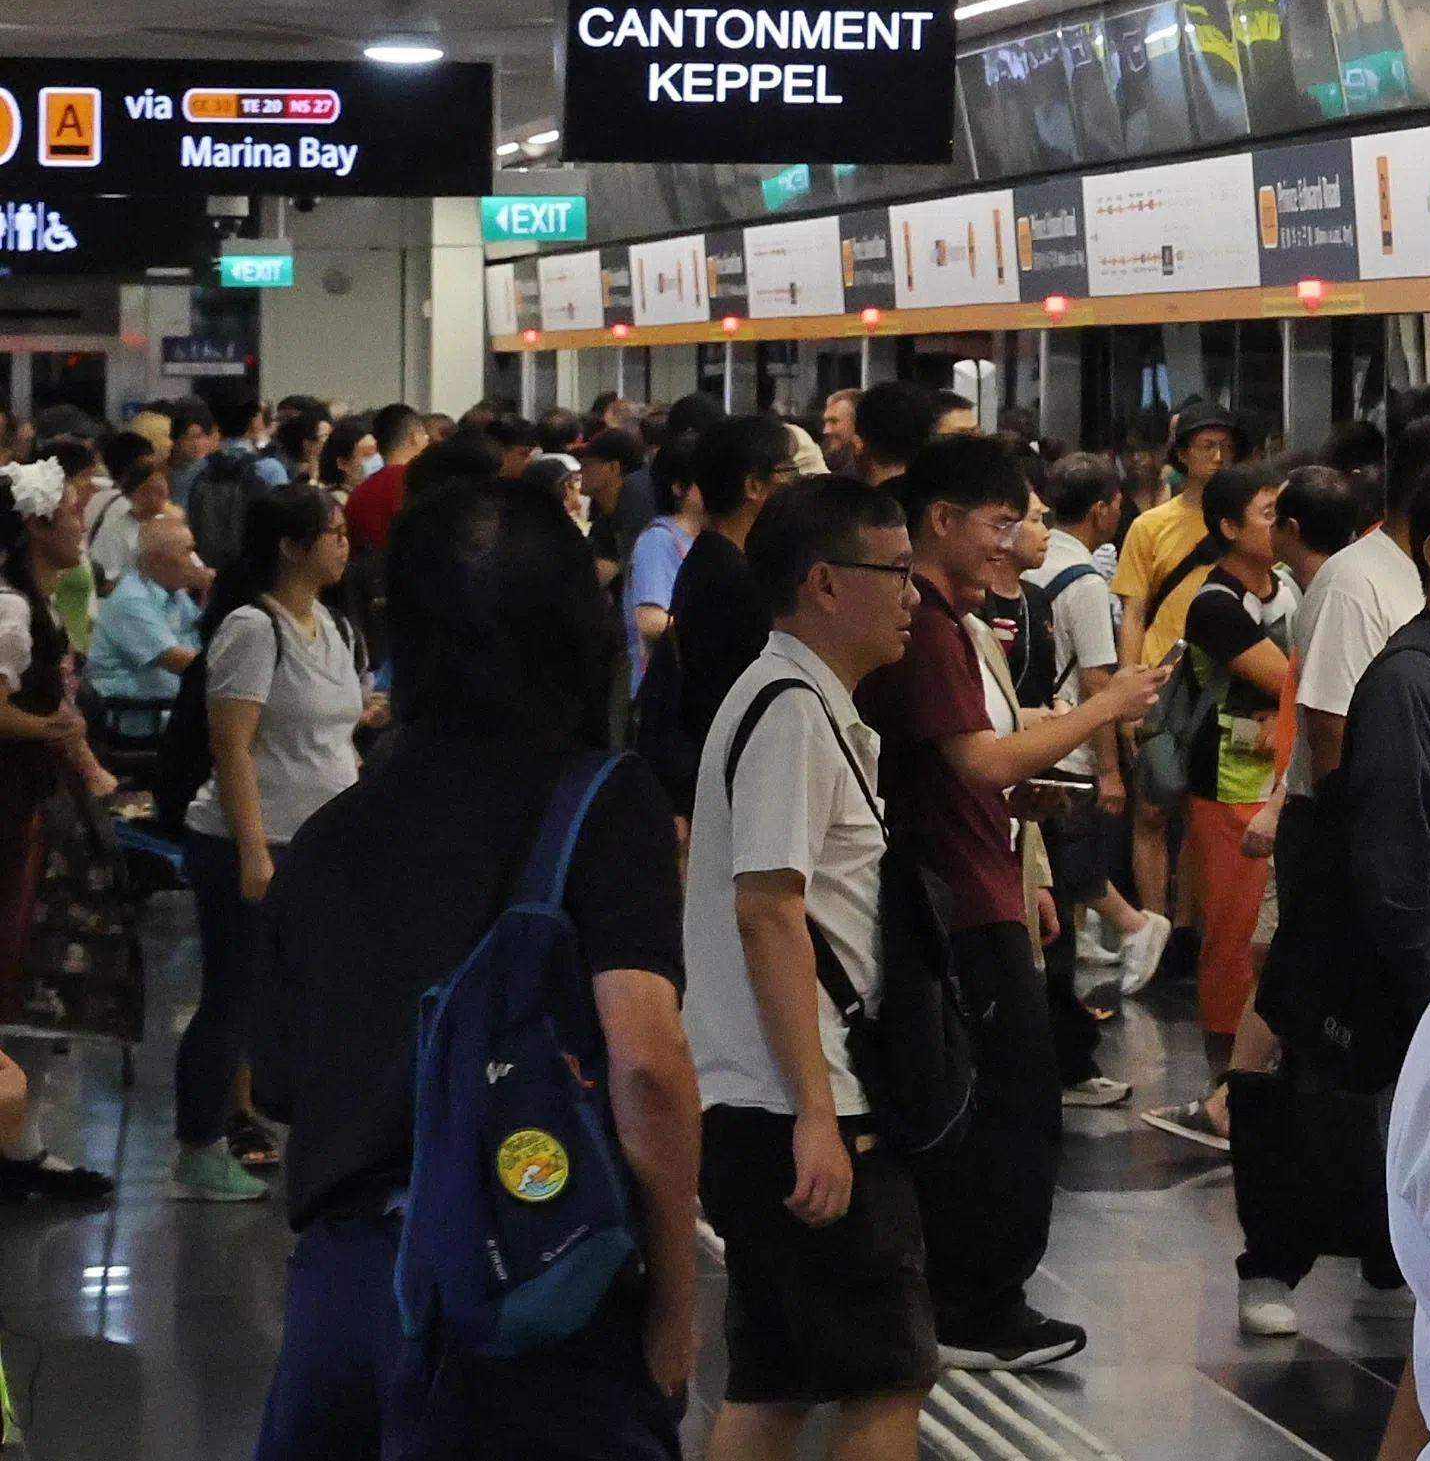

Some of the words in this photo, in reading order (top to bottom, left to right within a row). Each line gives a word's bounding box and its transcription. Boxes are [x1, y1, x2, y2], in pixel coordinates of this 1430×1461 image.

[578, 7, 933, 50] CANTONMENT
[648, 62, 843, 104] KEPPEL
[55, 103, 84, 139] A
[124, 88, 173, 120] via
[180, 135, 292, 169] Marina
[299, 136, 359, 177] Bay
[511, 203, 571, 234] EXIT
